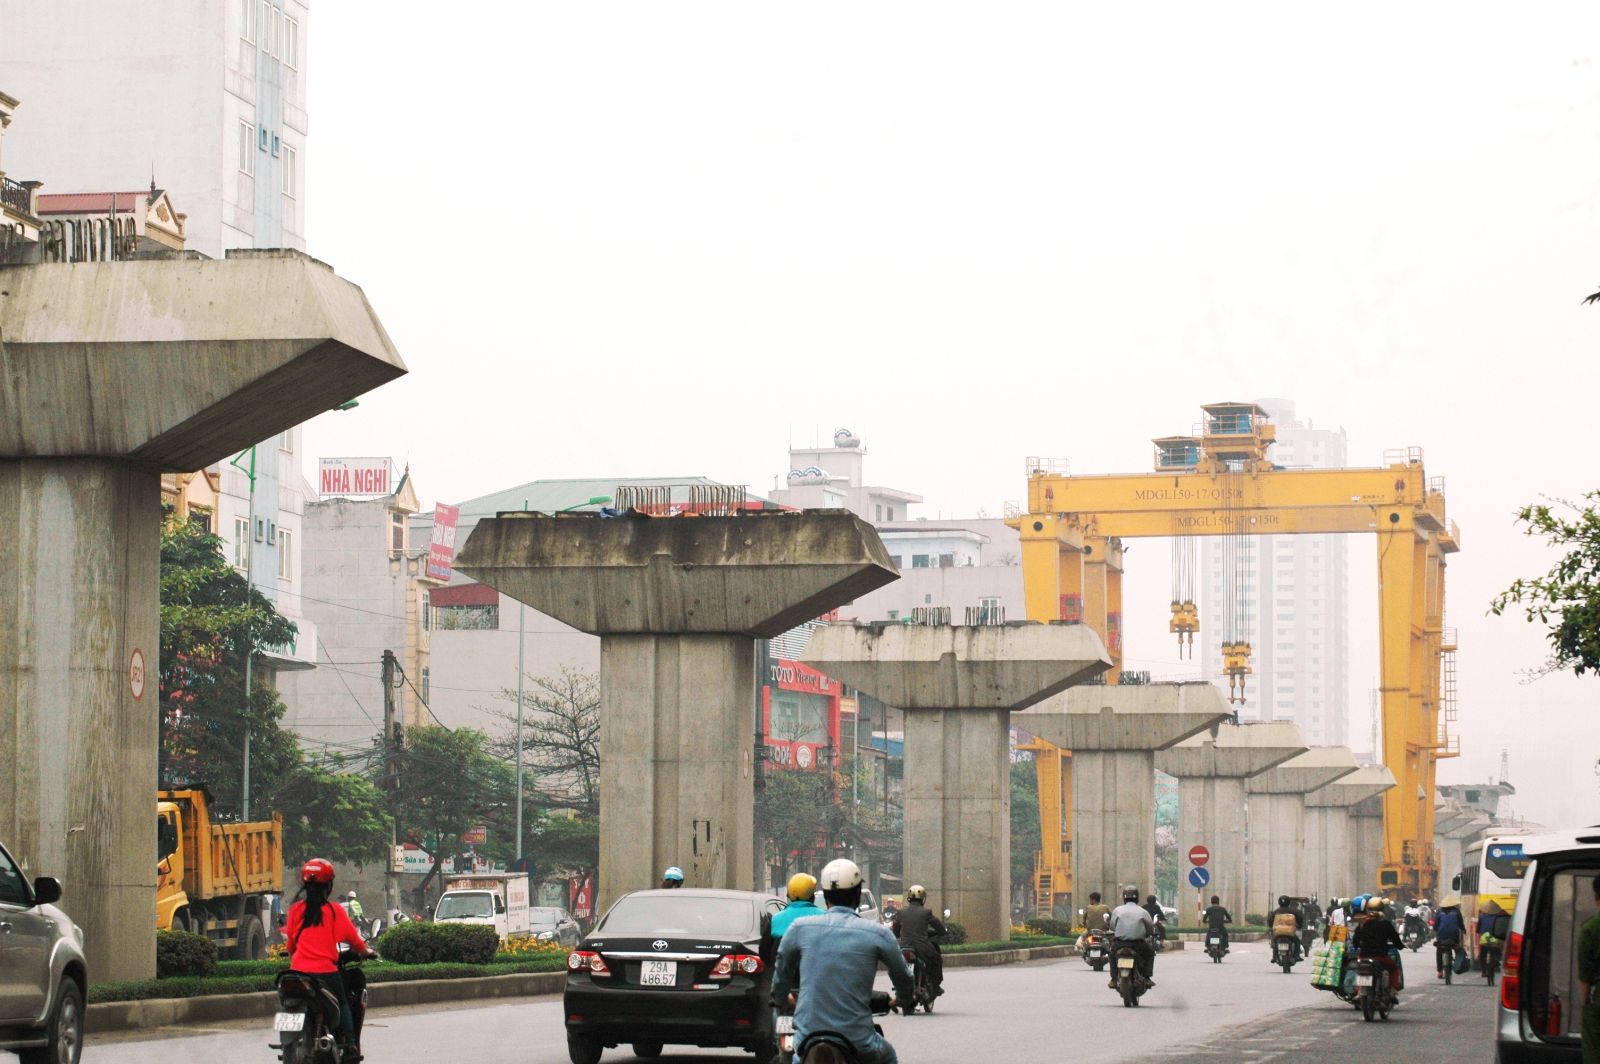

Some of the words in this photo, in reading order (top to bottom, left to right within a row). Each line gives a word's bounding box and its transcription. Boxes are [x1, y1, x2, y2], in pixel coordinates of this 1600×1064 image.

[322, 464, 350, 493] NHÀ
[354, 460, 387, 493] NGHỈ
[770, 664, 794, 683] TOTO
[650, 961, 668, 973] 29A
[642, 974, 675, 985] 486.57
